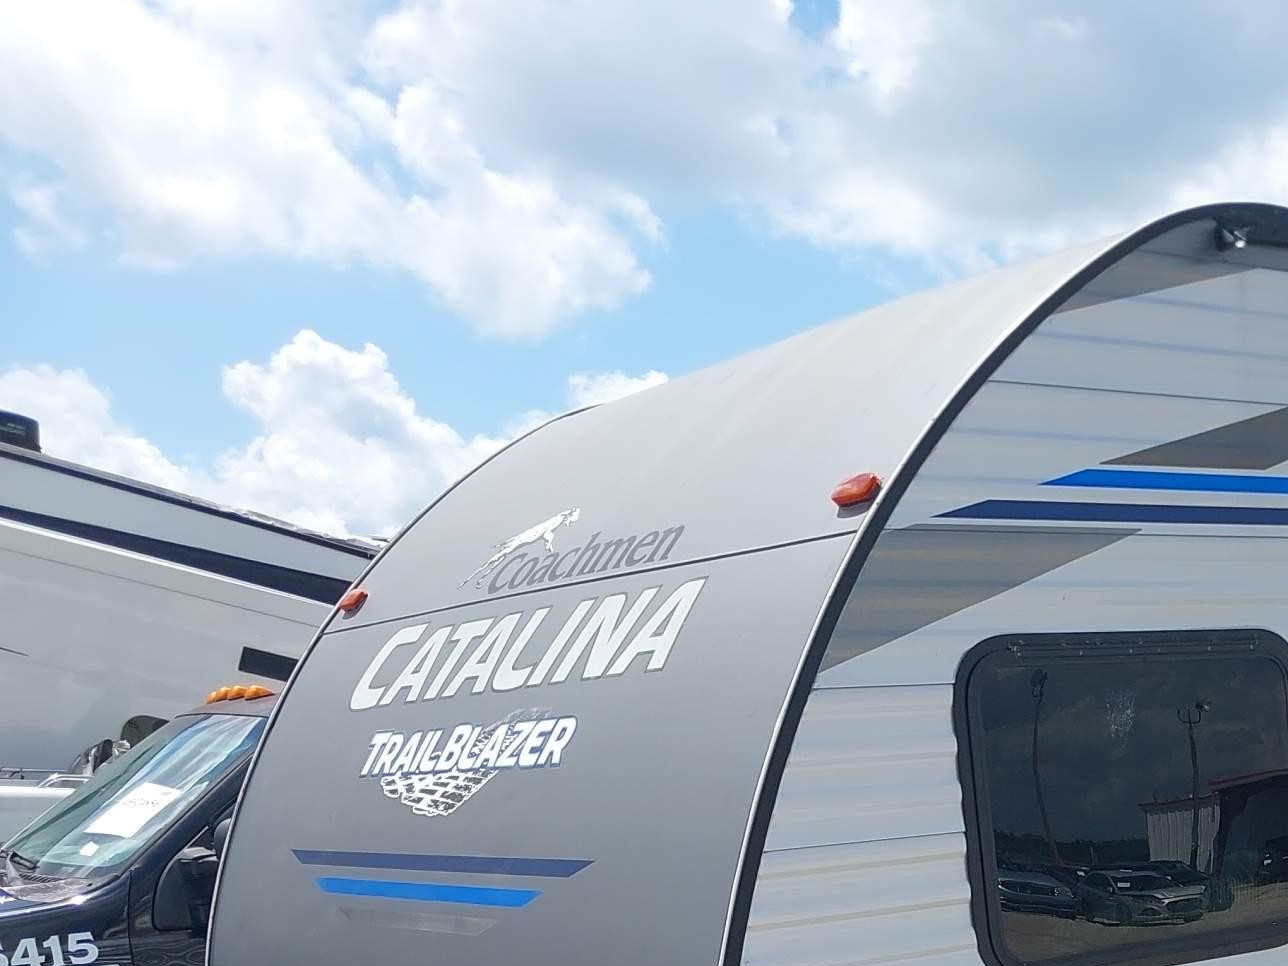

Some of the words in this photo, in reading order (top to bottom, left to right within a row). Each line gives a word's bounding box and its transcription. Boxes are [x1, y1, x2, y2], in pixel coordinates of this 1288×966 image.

[487, 525, 685, 594] Coachmen
[349, 575, 709, 711] CATALINA
[360, 715, 578, 779] TRAILBLAZER
